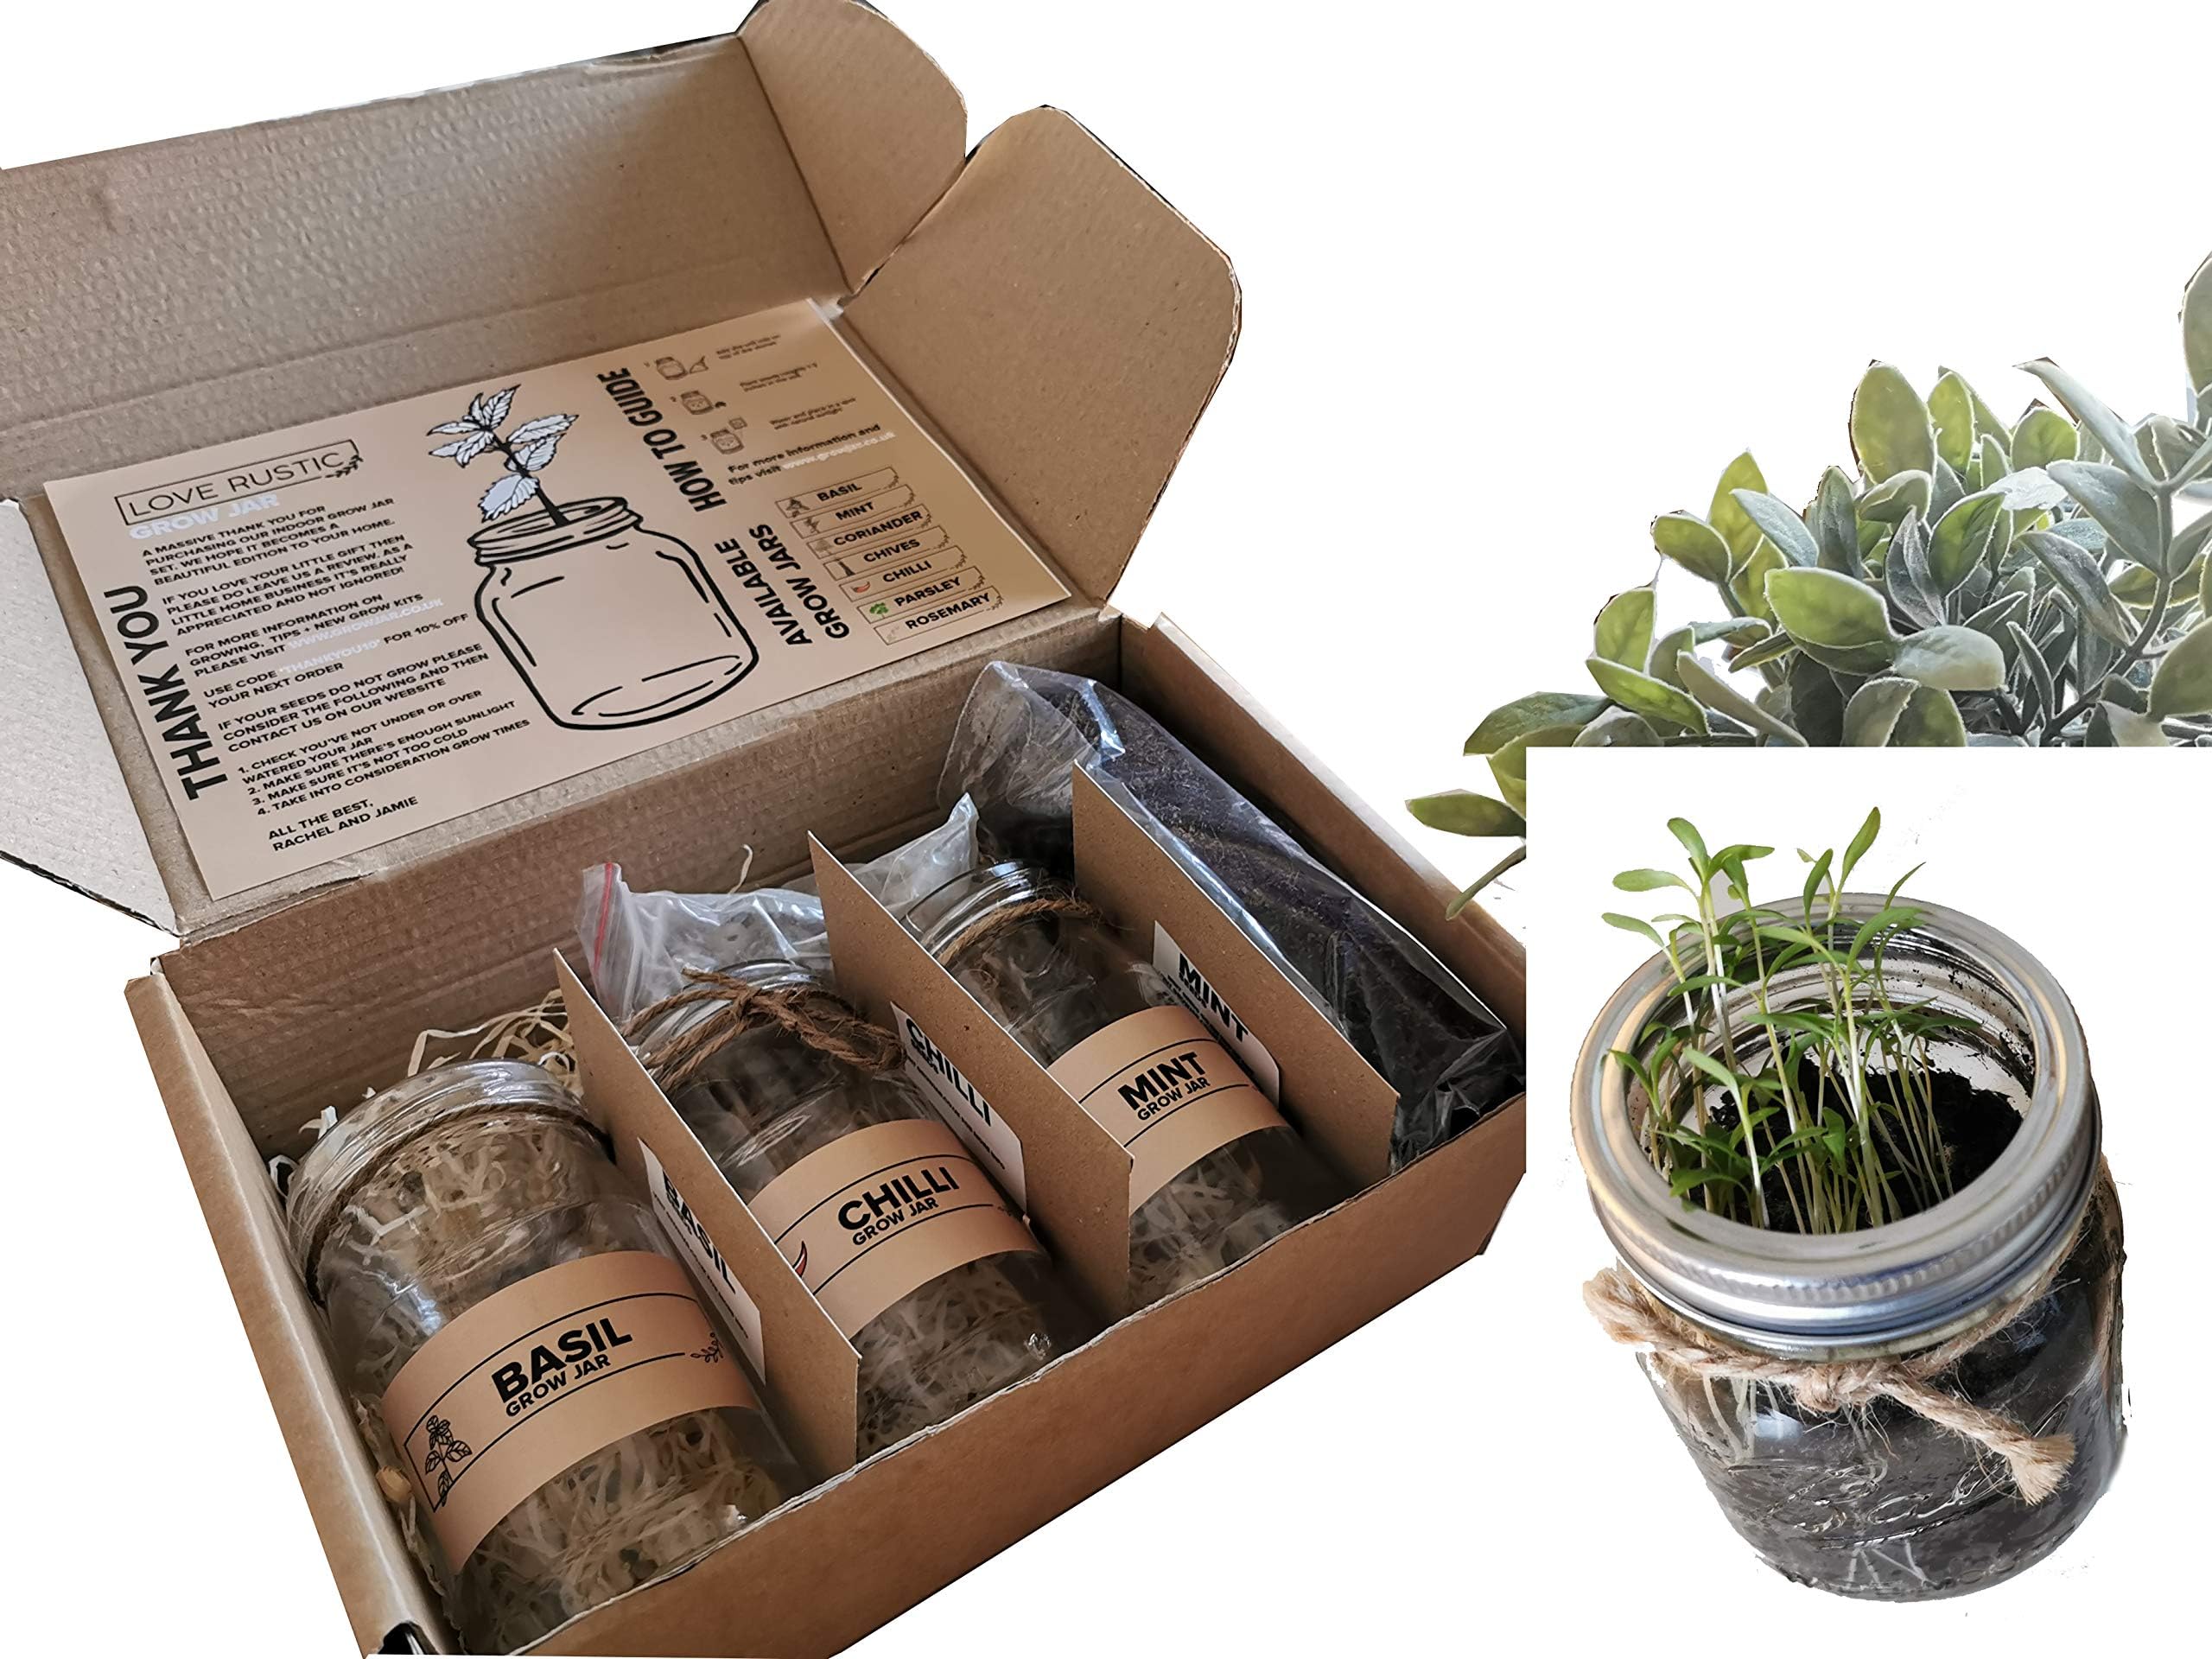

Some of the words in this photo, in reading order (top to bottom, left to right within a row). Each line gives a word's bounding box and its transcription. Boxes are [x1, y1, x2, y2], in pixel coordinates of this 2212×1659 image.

[596, 367, 663, 427] GUIDE
[643, 429, 686, 460] TO
[129, 482, 219, 517] LOVE
[227, 452, 344, 493] RUSTIC
[664, 461, 727, 512] HOW
[817, 482, 862, 502] BASIL
[835, 501, 875, 521] MINT
[129, 507, 219, 540] GROW
[228, 493, 280, 518] JAR
[144, 538, 237, 566] PURCHASING
[238, 531, 269, 543] OUR
[270, 515, 324, 535] INDOOR
[327, 504, 366, 519] GROW
[371, 498, 394, 509] JAR
[154, 533, 215, 554] MASSIVE
[217, 521, 264, 537] THANK
[266, 512, 296, 525] YOU
[297, 505, 326, 518] FOR
[749, 523, 801, 571] JARS
[833, 510, 924, 546] CORIANDER
[149, 563, 178, 575] SET.
[179, 556, 202, 568] WE
[204, 547, 244, 562] HOPE
[245, 543, 257, 552] IT
[260, 525, 327, 548] BECOMES
[153, 562, 231, 585] BEAUTIFUL
[232, 545, 288, 566] EDITION
[289, 540, 309, 550] TO
[310, 529, 349, 544] YOUR
[161, 595, 175, 605] IF
[176, 587, 209, 601] YOU
[211, 577, 248, 592] LOVE
[249, 565, 289, 581] YOUR
[290, 553, 335, 570] LITTLE
[336, 544, 365, 557] GIFT
[368, 534, 405, 549] THEN
[166, 595, 219, 615] PLEASE
[221, 589, 244, 601] DO
[245, 575, 289, 594] LEAVE
[290, 570, 311, 581] US
[314, 567, 324, 575] A
[383, 546, 400, 556] AS
[863, 538, 920, 563] CHIVES
[882, 560, 932, 584] CHILLI
[170, 607, 217, 626] LITTLE
[219, 595, 262, 613] HOME
[264, 575, 332, 600] BUSINESS
[333, 569, 359, 580] IT'S
[359, 554, 406, 573] REALLY
[176, 603, 272, 636] APPRECIATED
[276, 594, 305, 608] AND
[307, 584, 335, 598] NOT
[339, 565, 404, 589] IGNORED!
[268, 628, 301, 643] TIPS
[313, 614, 345, 631] NEW
[348, 601, 390, 620] GROW
[392, 593, 423, 607] KITS
[714, 537, 813, 647] AVAILABLE
[785, 576, 850, 640] GROW
[893, 575, 962, 607] PARSLEY
[905, 591, 992, 631] ROSEMARY
[104, 586, 169, 665] YOU
[184, 642, 214, 657] FOR
[216, 629, 260, 647] MORE
[261, 600, 359, 634] INFORMATION
[361, 593, 383, 605] ON
[202, 683, 233, 697] USE
[235, 670, 277, 688] CODE
[383, 630, 412, 644] FOR
[414, 622, 441, 634] 10%
[442, 613, 468, 626] OFF
[193, 655, 248, 677] PLEASE
[249, 644, 285, 659] VISIT
[207, 690, 251, 709] YOUR
[252, 677, 290, 695] NEXT
[294, 662, 344, 682] ORDER
[217, 720, 232, 730] IF
[233, 706, 277, 724] YOUR
[279, 690, 327, 711] SEEDS
[327, 683, 351, 696] DO
[353, 672, 382, 689] NOT
[385, 658, 429, 677] GROW
[431, 643, 482, 664] PLEASE
[222, 711, 300, 741] CONSIDER
[300, 701, 331, 715] THE
[332, 675, 416, 707] FOLLOWING
[420, 664, 449, 680] AND
[450, 652, 489, 669] THEN
[227, 723, 297, 752] CONTACT
[300, 716, 322, 728] US
[324, 708, 347, 721] ON
[349, 697, 382, 713] OUR
[384, 677, 446, 702] WEBSITE
[137, 664, 228, 801] THANK
[241, 759, 307, 784] WATERED
[307, 745, 346, 762] YOUR
[350, 736, 373, 750] JAR
[246, 786, 261, 795] 2.
[262, 771, 302, 790] MAKE
[303, 759, 340, 776] SURE
[340, 741, 396, 763] THERE'S
[397, 721, 453, 745] ENOUGH
[454, 700, 515, 726] SUNLIGHT
[251, 749, 297, 770] CHECK
[298, 732, 349, 753] YOU'VE
[350, 722, 377, 737] NOT
[379, 708, 425, 727] UNDER
[427, 701, 446, 712] OR
[448, 690, 482, 705] OVER
[251, 797, 265, 805] 3.
[266, 781, 308, 800] MAKE
[308, 768, 345, 786] SURE
[346, 760, 371, 773] IT'S
[372, 749, 399, 765] NOT
[401, 741, 430, 754] TOO
[432, 728, 467, 744] COLD
[270, 793, 308, 810] TAKE
[308, 782, 342, 798] INTO
[344, 745, 450, 786] CONSIDERATION
[451, 731, 490, 750] GROW
[491, 719, 530, 735] TIMES
[268, 824, 296, 840] ALL
[297, 812, 330, 829] THE
[331, 798, 373, 818] BEST,
[271, 825, 335, 851] RACHEL
[338, 812, 371, 830] AND
[374, 795, 418, 817] JAMIE
[1179, 952, 1249, 1042] MINT
[906, 1018, 991, 1127] CHILLI
[1117, 1052, 1205, 1110] MINT
[1137, 1087, 1183, 1120] GROW
[1185, 1077, 1211, 1094] JAR
[838, 1167, 959, 1230] CHILLI
[853, 1210, 905, 1245] GROW
[909, 1197, 939, 1217] JAR
[662, 1169, 735, 1294] BASIL
[491, 1317, 633, 1404] BASIL
[505, 1371, 568, 1418] GROW
[574, 1353, 611, 1381] JAR
